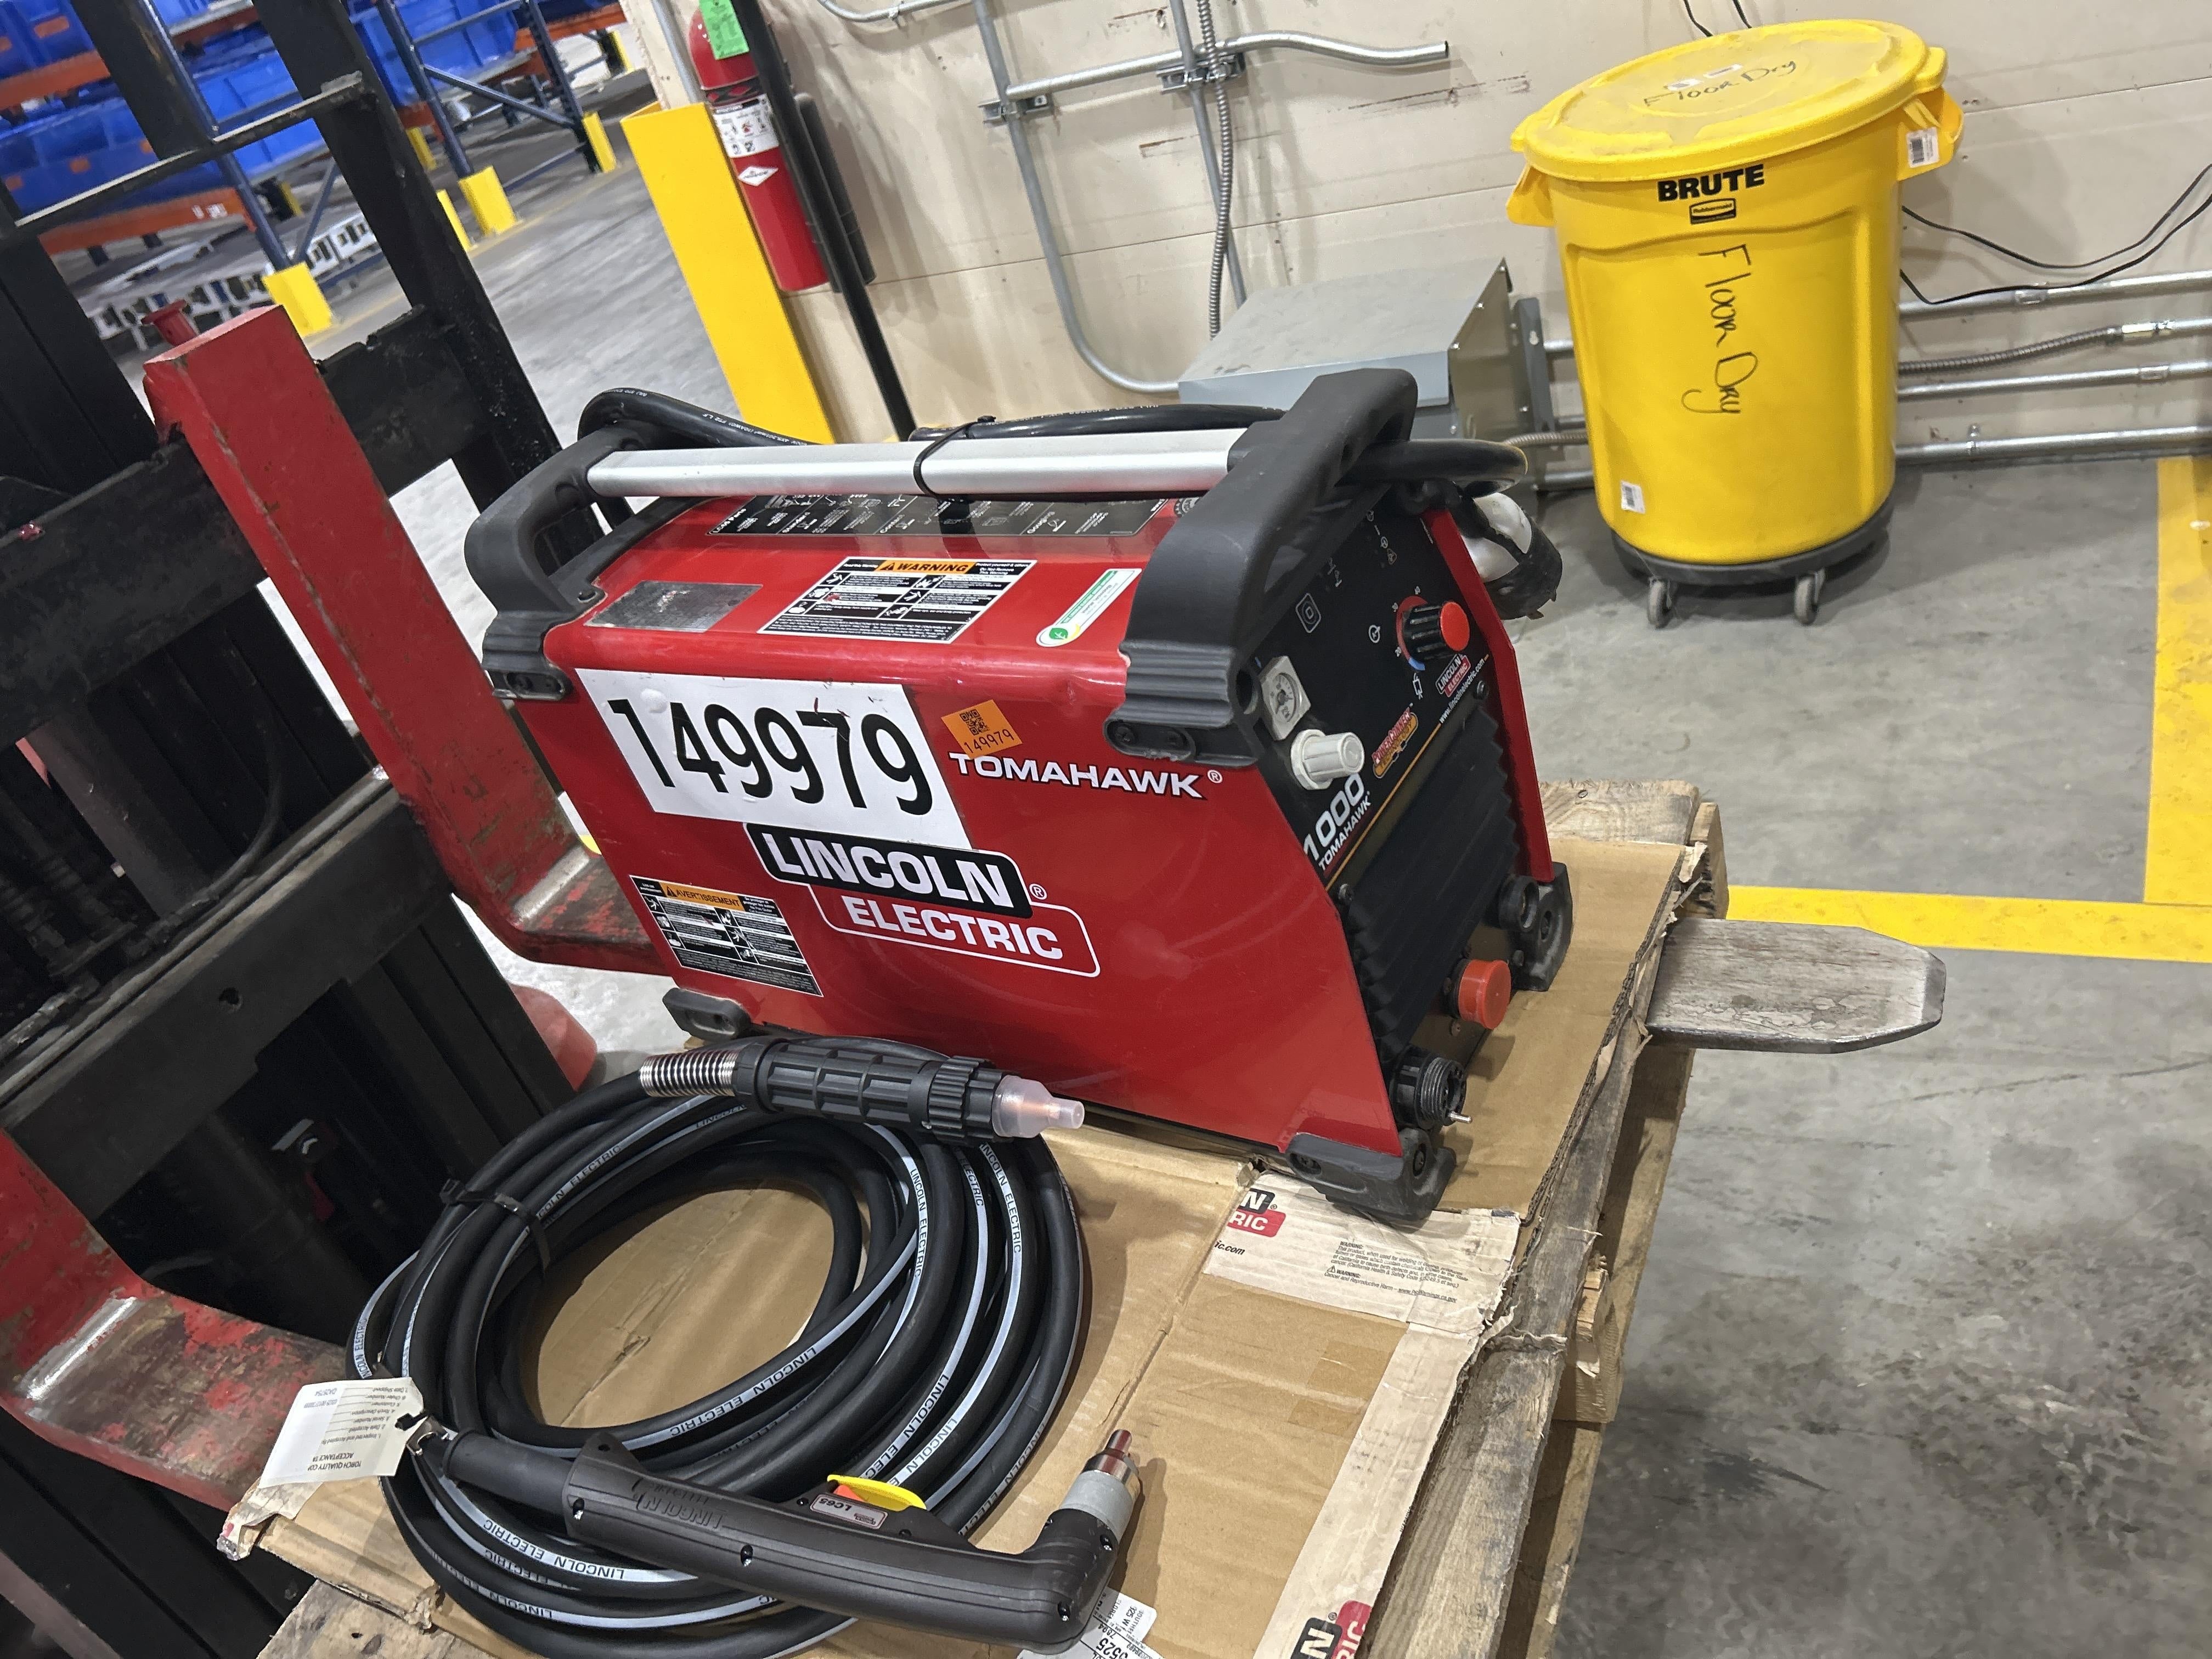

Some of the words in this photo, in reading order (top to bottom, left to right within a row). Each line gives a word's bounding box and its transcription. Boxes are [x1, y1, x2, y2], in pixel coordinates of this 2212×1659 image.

[1657, 164, 1764, 201] BRUTE
[898, 563, 967, 572] WARNING
[1437, 656, 1462, 690] LINCOLN
[1439, 658, 1485, 724] www.lincolnelectric.com
[1447, 662, 1468, 692] ELECTRIC
[607, 698, 933, 816] 149979
[964, 728, 1015, 754] 149979
[949, 752, 1204, 798] TOMAHAWK
[1303, 773, 1364, 860] 1000
[1318, 795, 1371, 871] TOMAHAWK
[761, 833, 1014, 907] LINCOLN
[676, 889, 740, 907] AVERTISSEMENT
[841, 895, 1063, 960] ELECTRIC
[696, 1104, 747, 1128] LINCOLN
[570, 1145, 622, 1187] ELECTRIC
[960, 1158, 984, 1206] ELECTRIC
[910, 1169, 926, 1211] LINCOLN
[1005, 1193, 1021, 1253] ELECTRIC
[915, 1218, 927, 1277] ELECTRIC
[753, 1347, 816, 1395] LINCOLN
[670, 1396, 743, 1436] ELECTRIC
[903, 1374, 949, 1438] LINCOLN
[318, 1462, 343, 1470] QUALITY
[319, 1452, 354, 1461] ACCEPTANCE
[343, 1460, 362, 1468] TORCH
[906, 1418, 957, 1474] LINCOLN
[1005, 1424, 1045, 1484] LINCOLN
[819, 1498, 852, 1511] LC65
[483, 1520, 545, 1560] ELECTRIC
[554, 1556, 624, 1579] LINCOLN
[490, 1592, 552, 1618] LINCOLN
[1098, 1623, 1116, 1639] 7894
